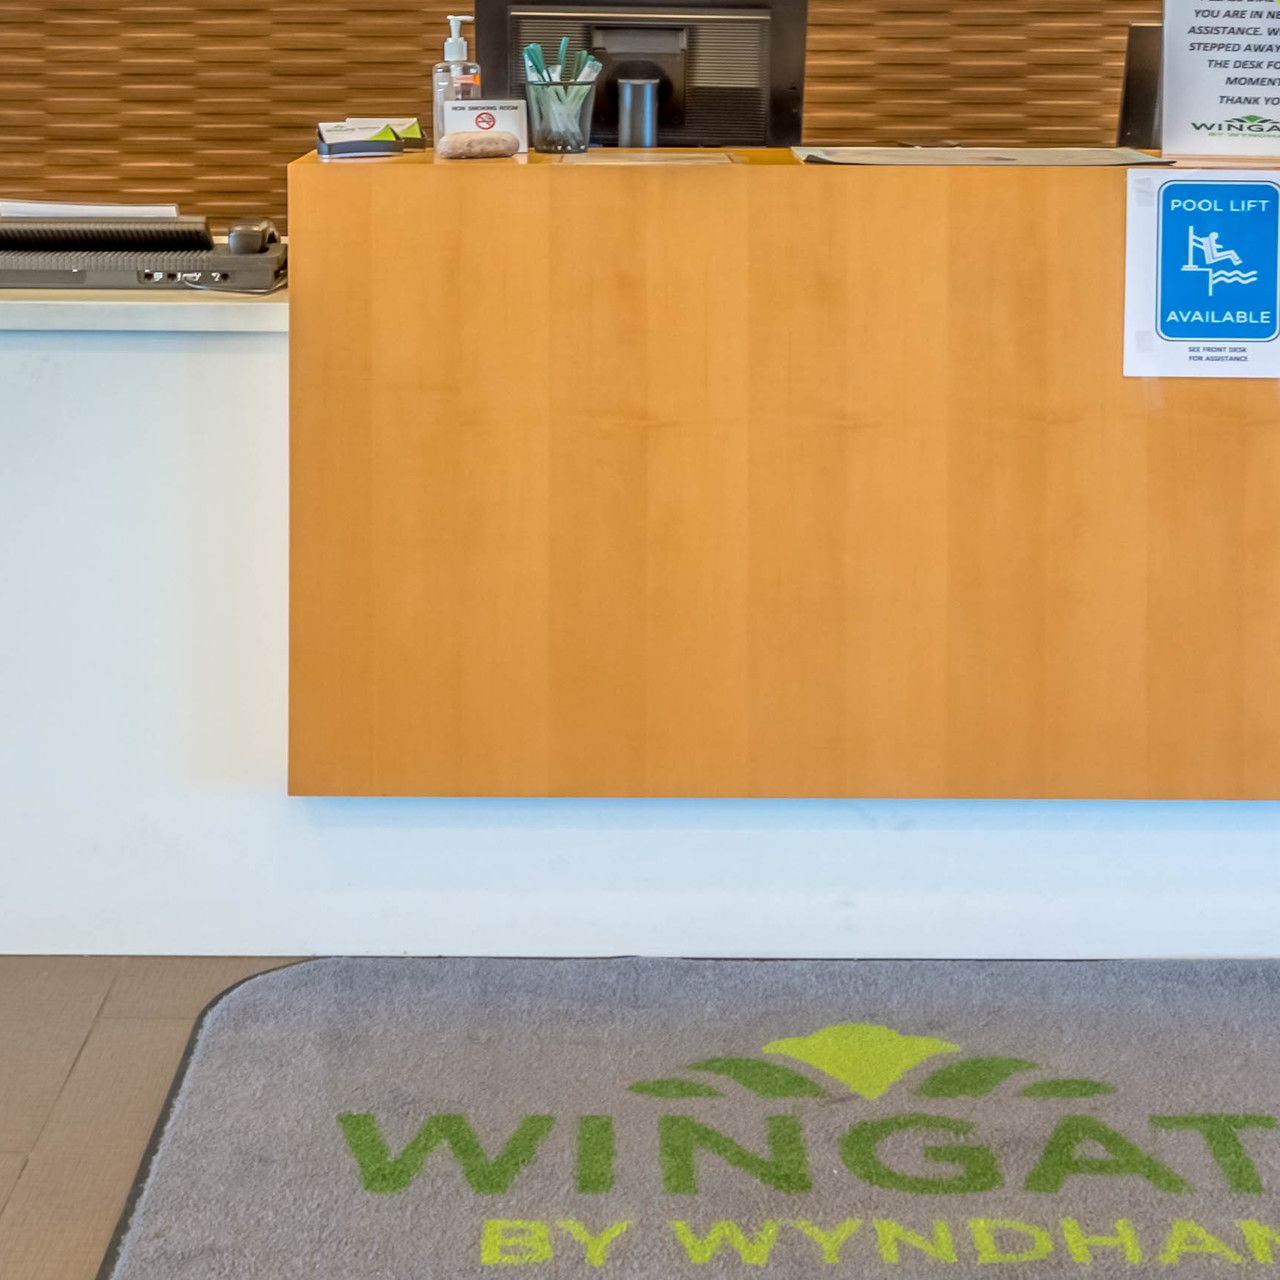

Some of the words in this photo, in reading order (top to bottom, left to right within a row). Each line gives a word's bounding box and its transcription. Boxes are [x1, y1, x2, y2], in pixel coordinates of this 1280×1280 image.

[1194, 9, 1221, 19] YOU
[1222, 10, 1248, 19] ARE
[1249, 10, 1263, 19] IN
[1187, 26, 1263, 36] ASSISTANCE.
[1189, 42, 1241, 52] STEPPED
[1207, 59, 1230, 69] THE
[1233, 60, 1264, 69] DESK
[1219, 95, 1261, 105] THANK
[1170, 199, 1223, 212] POOL
[1230, 199, 1270, 212] LIFT
[1166, 311, 1271, 324] AVAILABLE
[478, 1217, 633, 1266] BY
